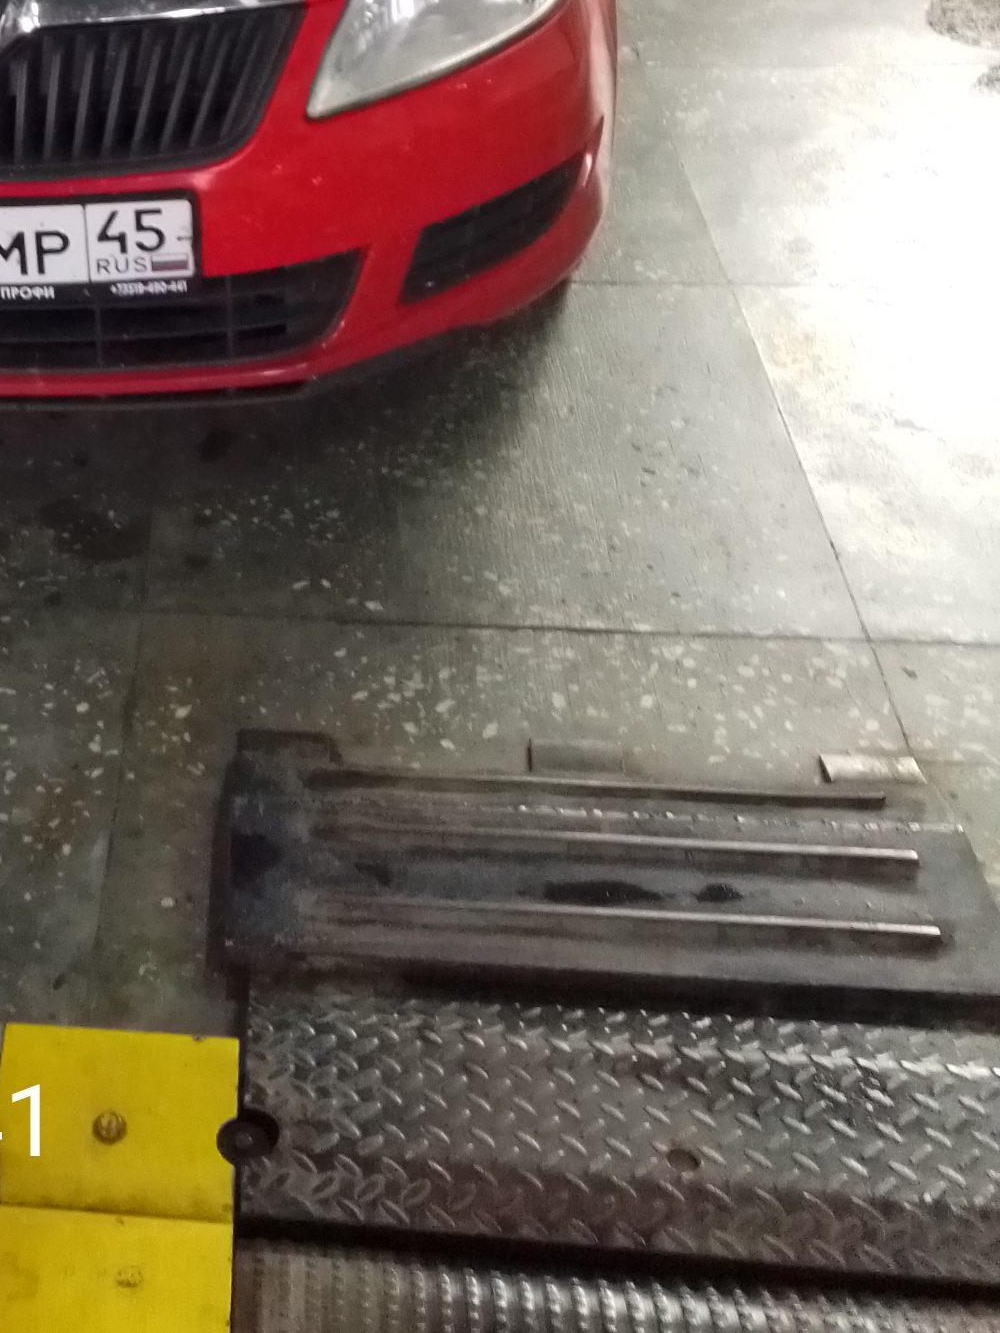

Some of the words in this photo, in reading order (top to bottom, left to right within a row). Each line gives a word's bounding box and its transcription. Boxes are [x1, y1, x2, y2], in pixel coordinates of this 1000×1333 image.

[97, 208, 165, 254] 45
[96, 256, 147, 274] RUS
[0, 285, 56, 300] ПРОФИ
